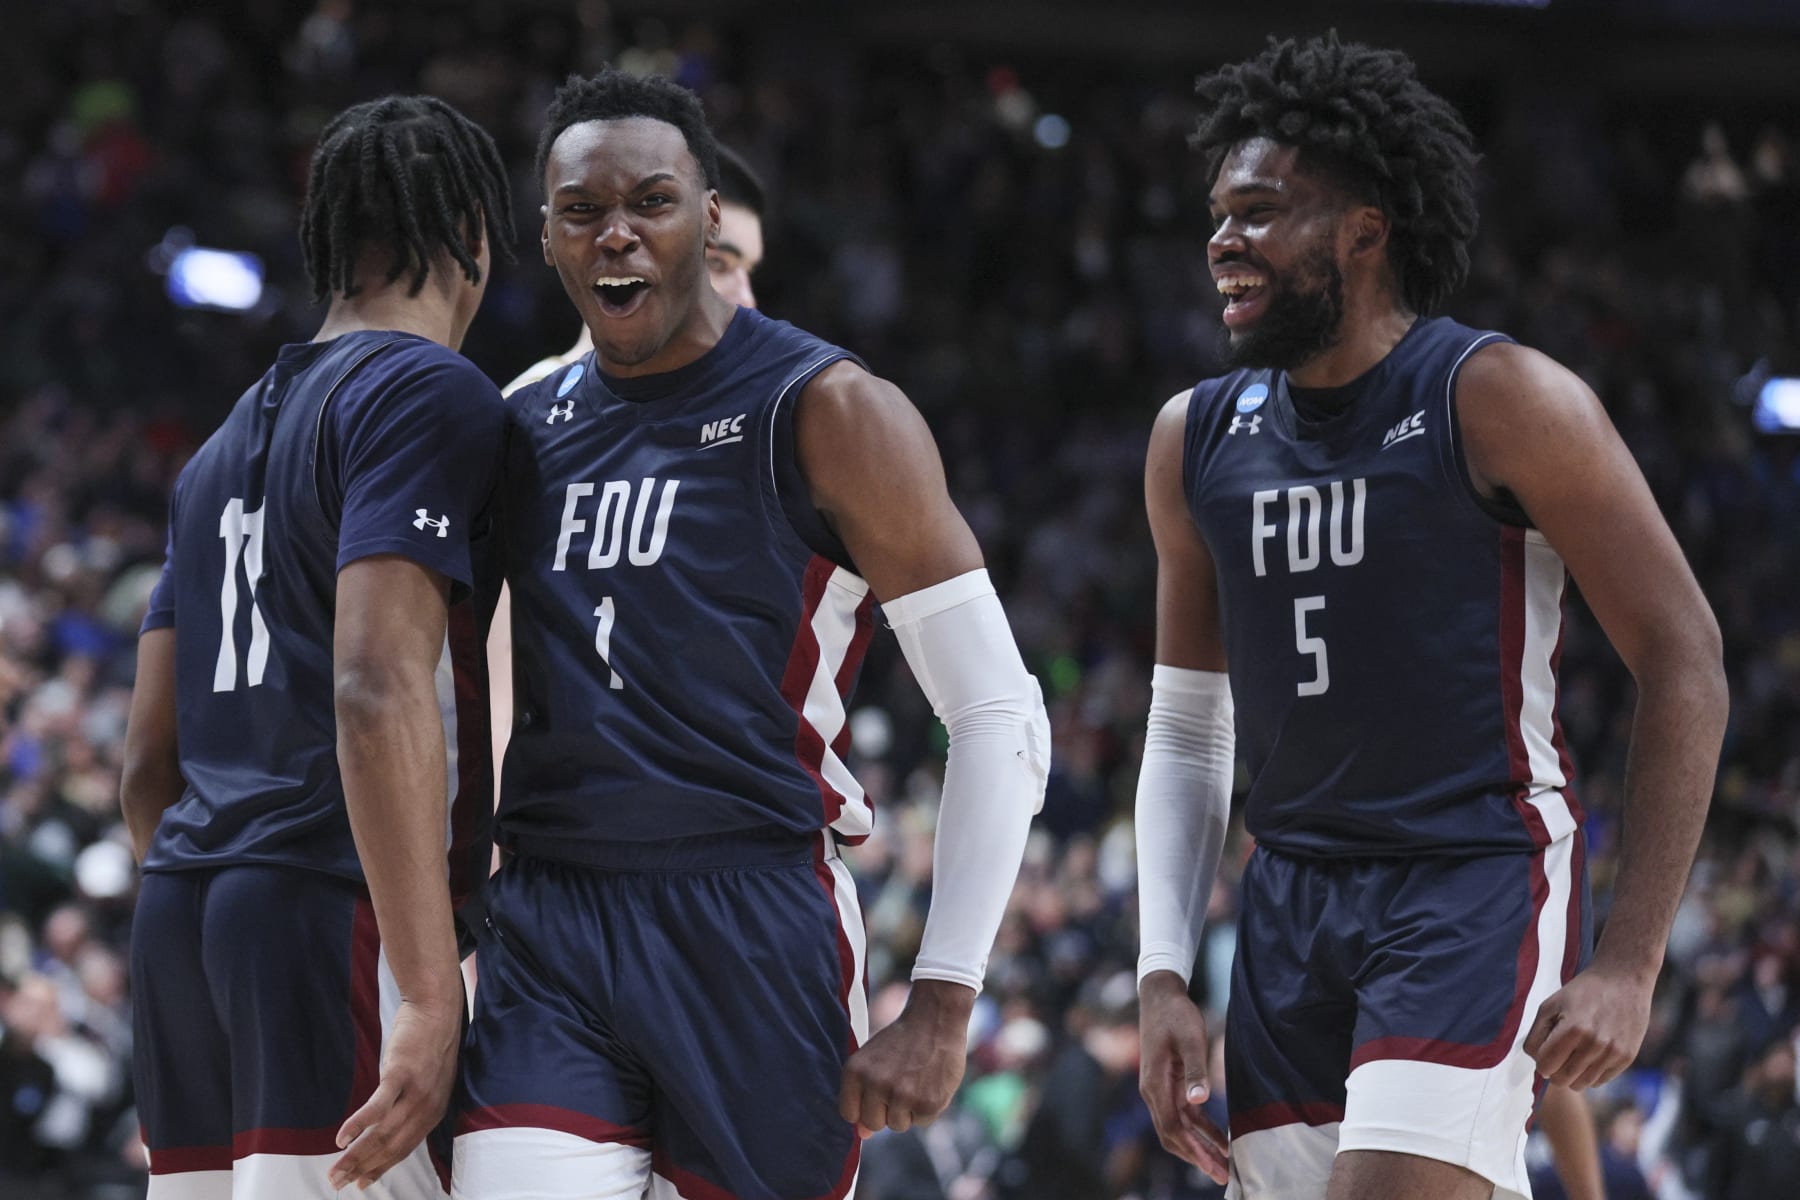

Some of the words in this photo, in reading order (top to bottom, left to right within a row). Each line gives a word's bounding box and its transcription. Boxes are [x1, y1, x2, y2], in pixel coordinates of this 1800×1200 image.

[699, 413, 747, 444] NEC
[1382, 409, 1426, 446] NEC
[552, 477, 681, 571] FDU
[1252, 477, 1367, 577] FDU
[213, 496, 271, 693] 11
[593, 596, 624, 690] 1
[1293, 594, 1330, 697] 5
